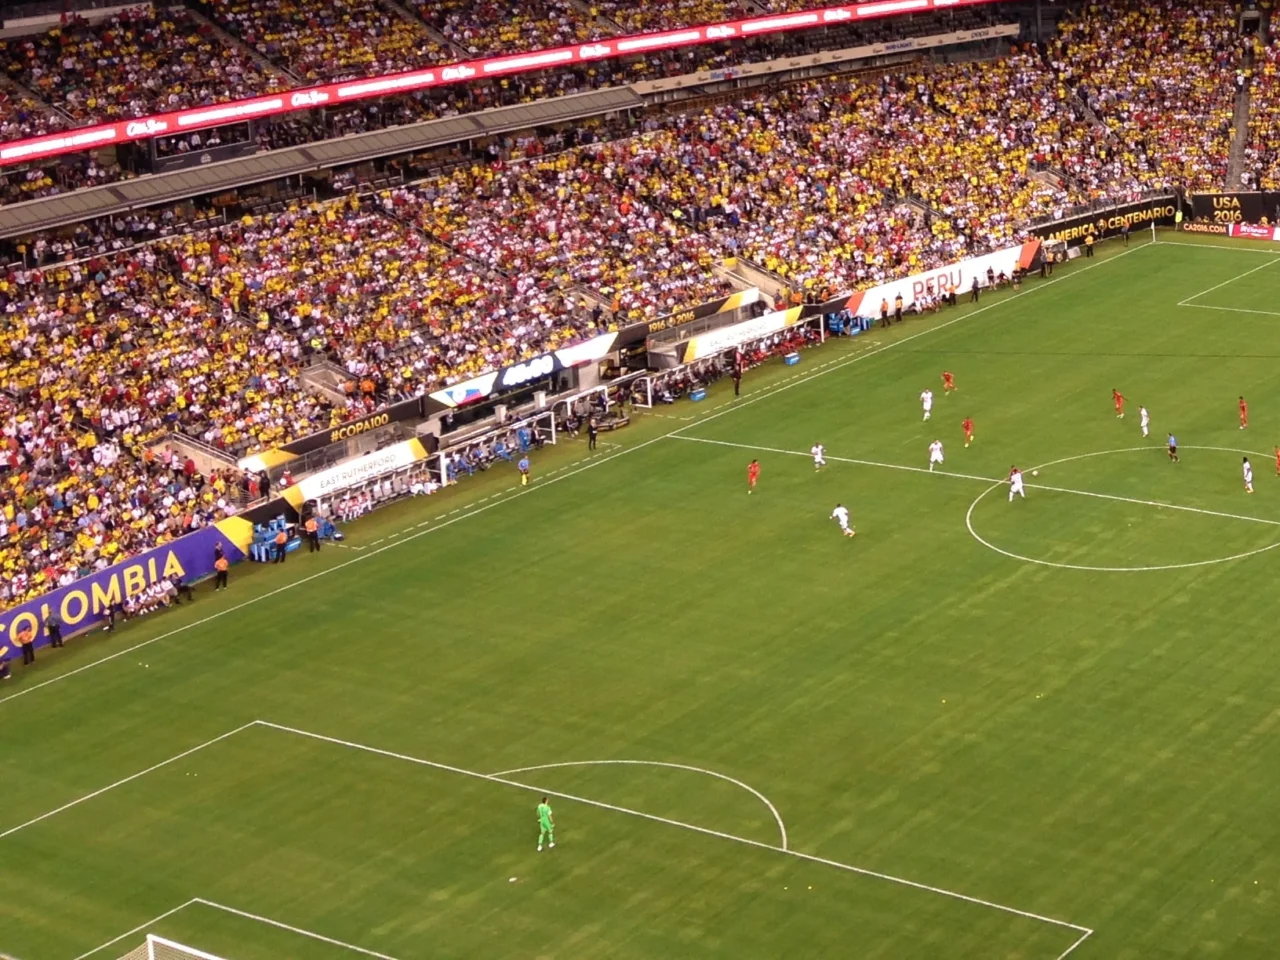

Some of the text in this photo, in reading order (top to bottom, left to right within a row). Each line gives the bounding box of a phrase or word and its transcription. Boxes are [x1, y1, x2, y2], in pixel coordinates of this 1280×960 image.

[1213, 197, 1241, 209] USA
[1213, 210, 1242, 222] 2016
[912, 270, 962, 300] PERU
[649, 311, 695, 333] 1916 2016
[330, 413, 389, 442] #COPA100
[320, 471, 340, 489] EAST
[341, 454, 396, 480] RUTHERFORD
